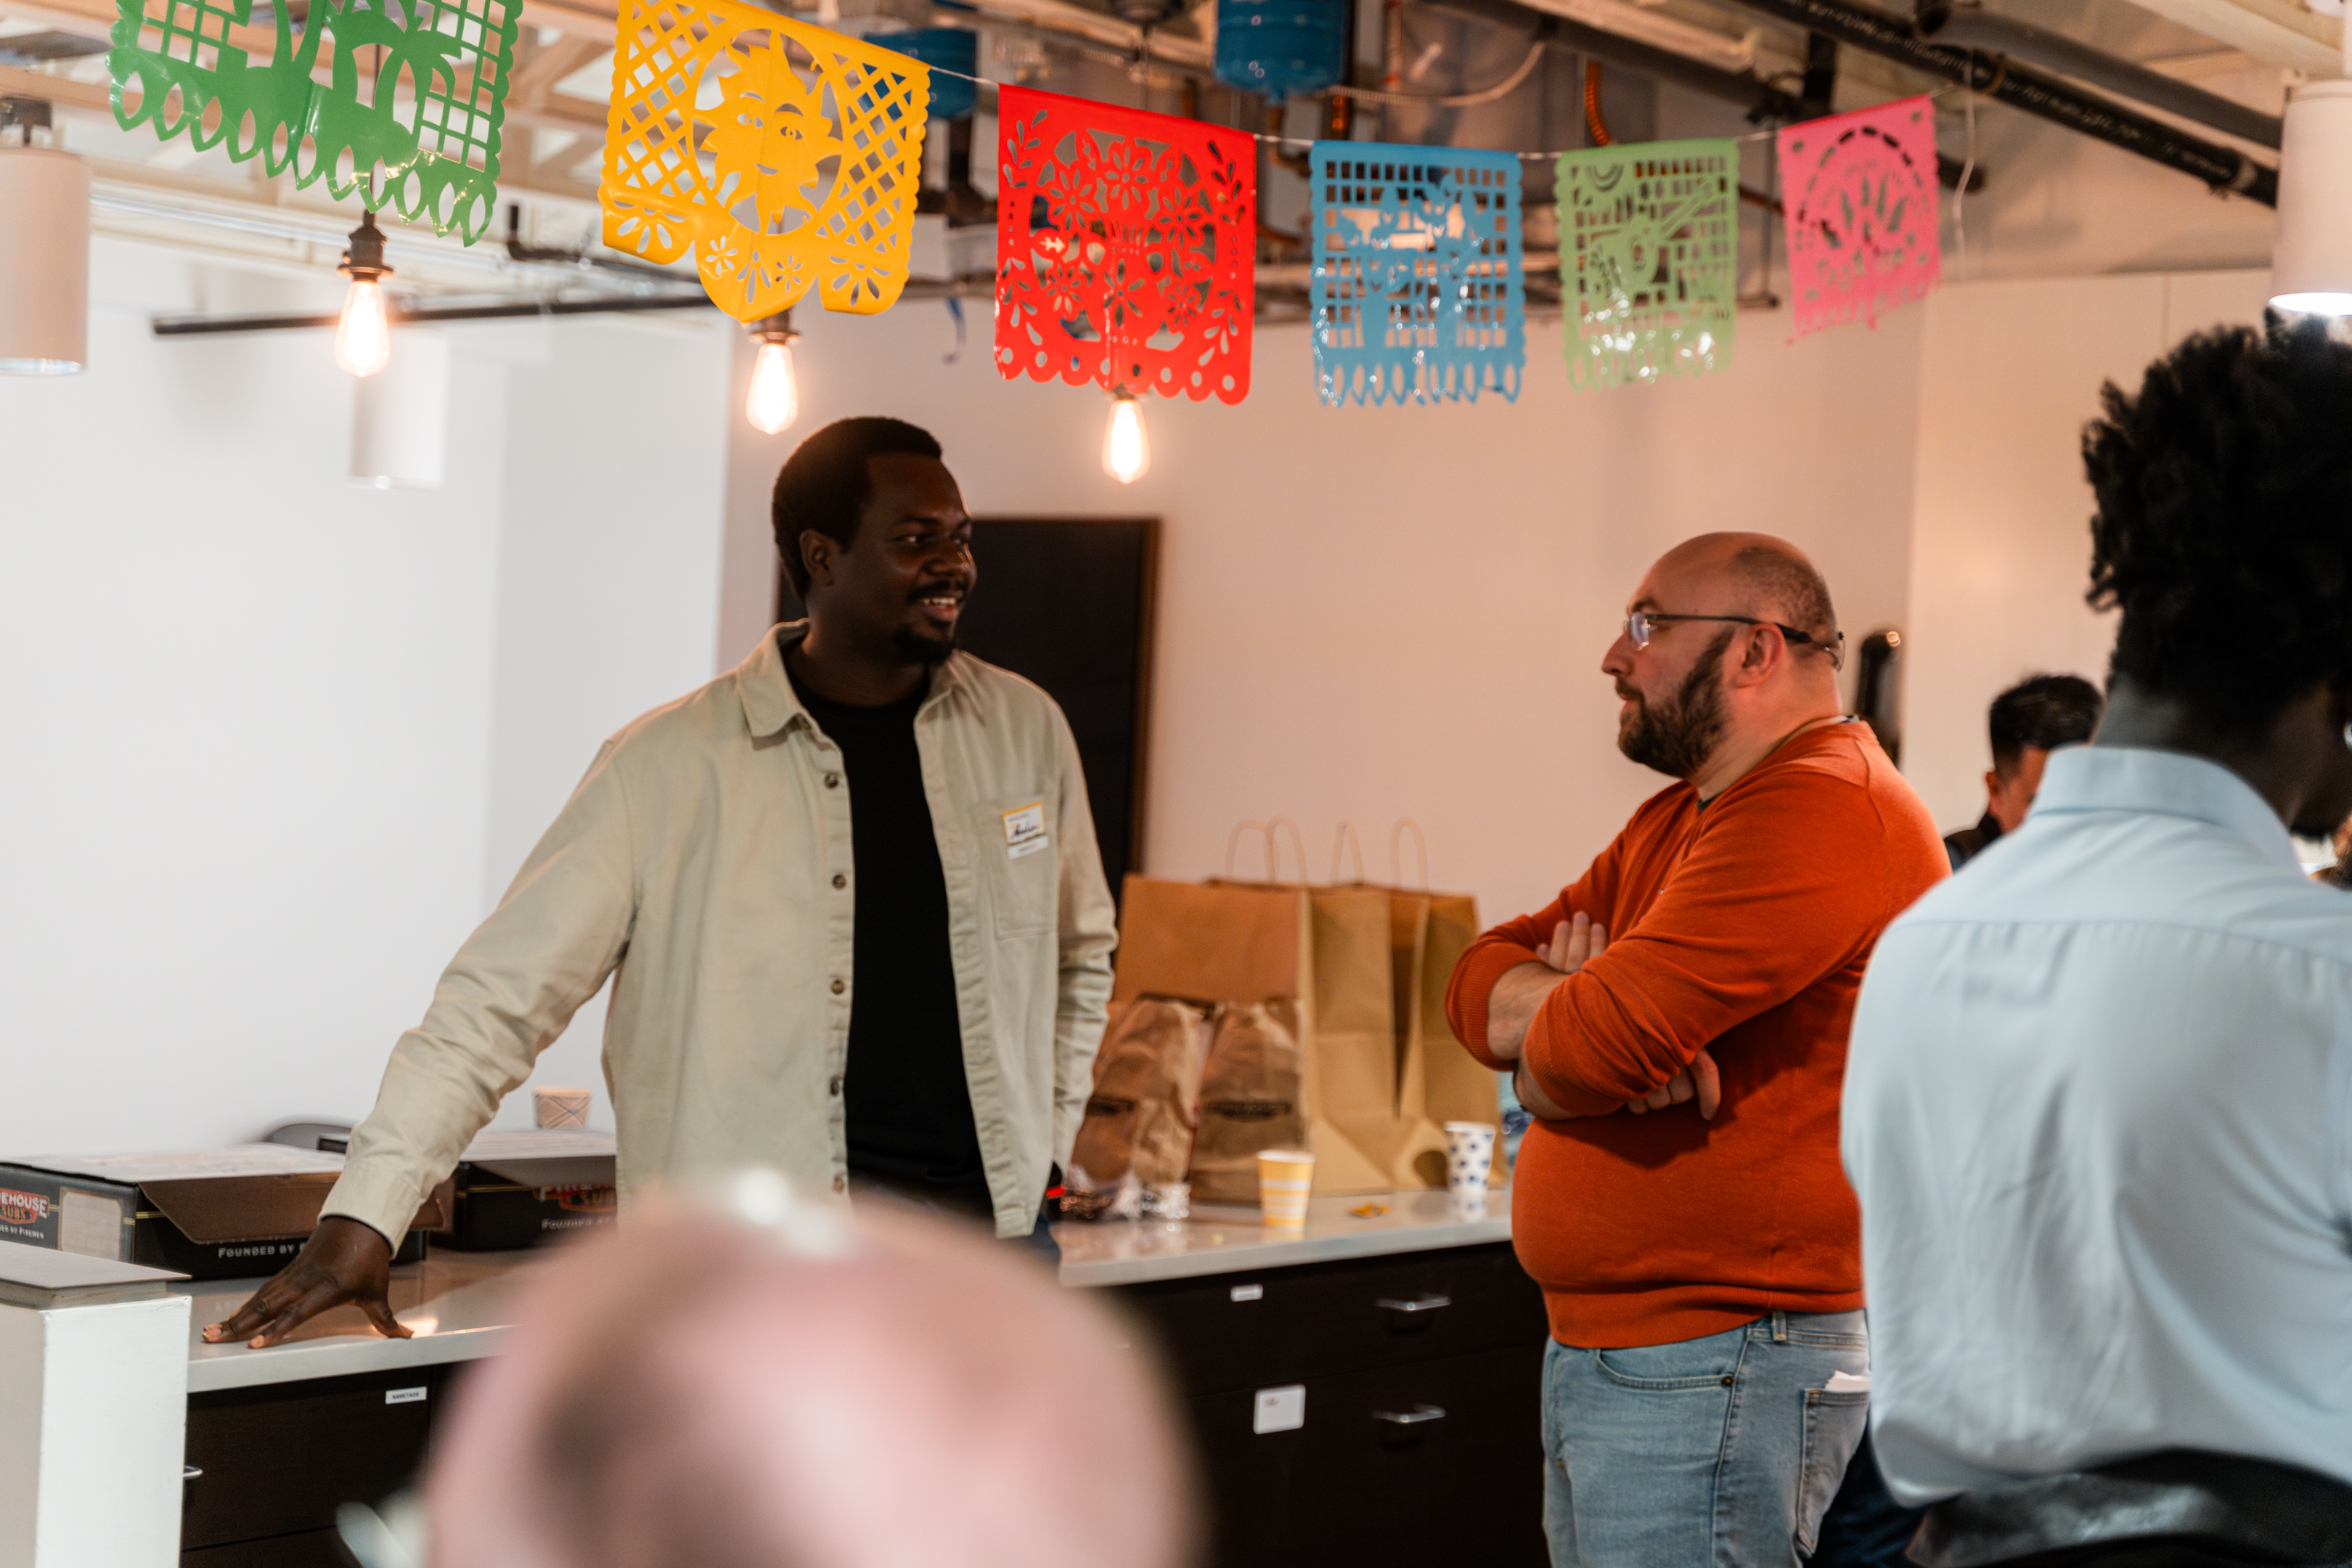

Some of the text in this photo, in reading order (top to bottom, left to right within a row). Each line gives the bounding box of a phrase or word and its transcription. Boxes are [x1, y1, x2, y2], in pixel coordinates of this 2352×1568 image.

[0, 1191, 48, 1219] EHOUSE
[219, 1246, 275, 1258] FOUNDED
[279, 1244, 295, 1254] BY
